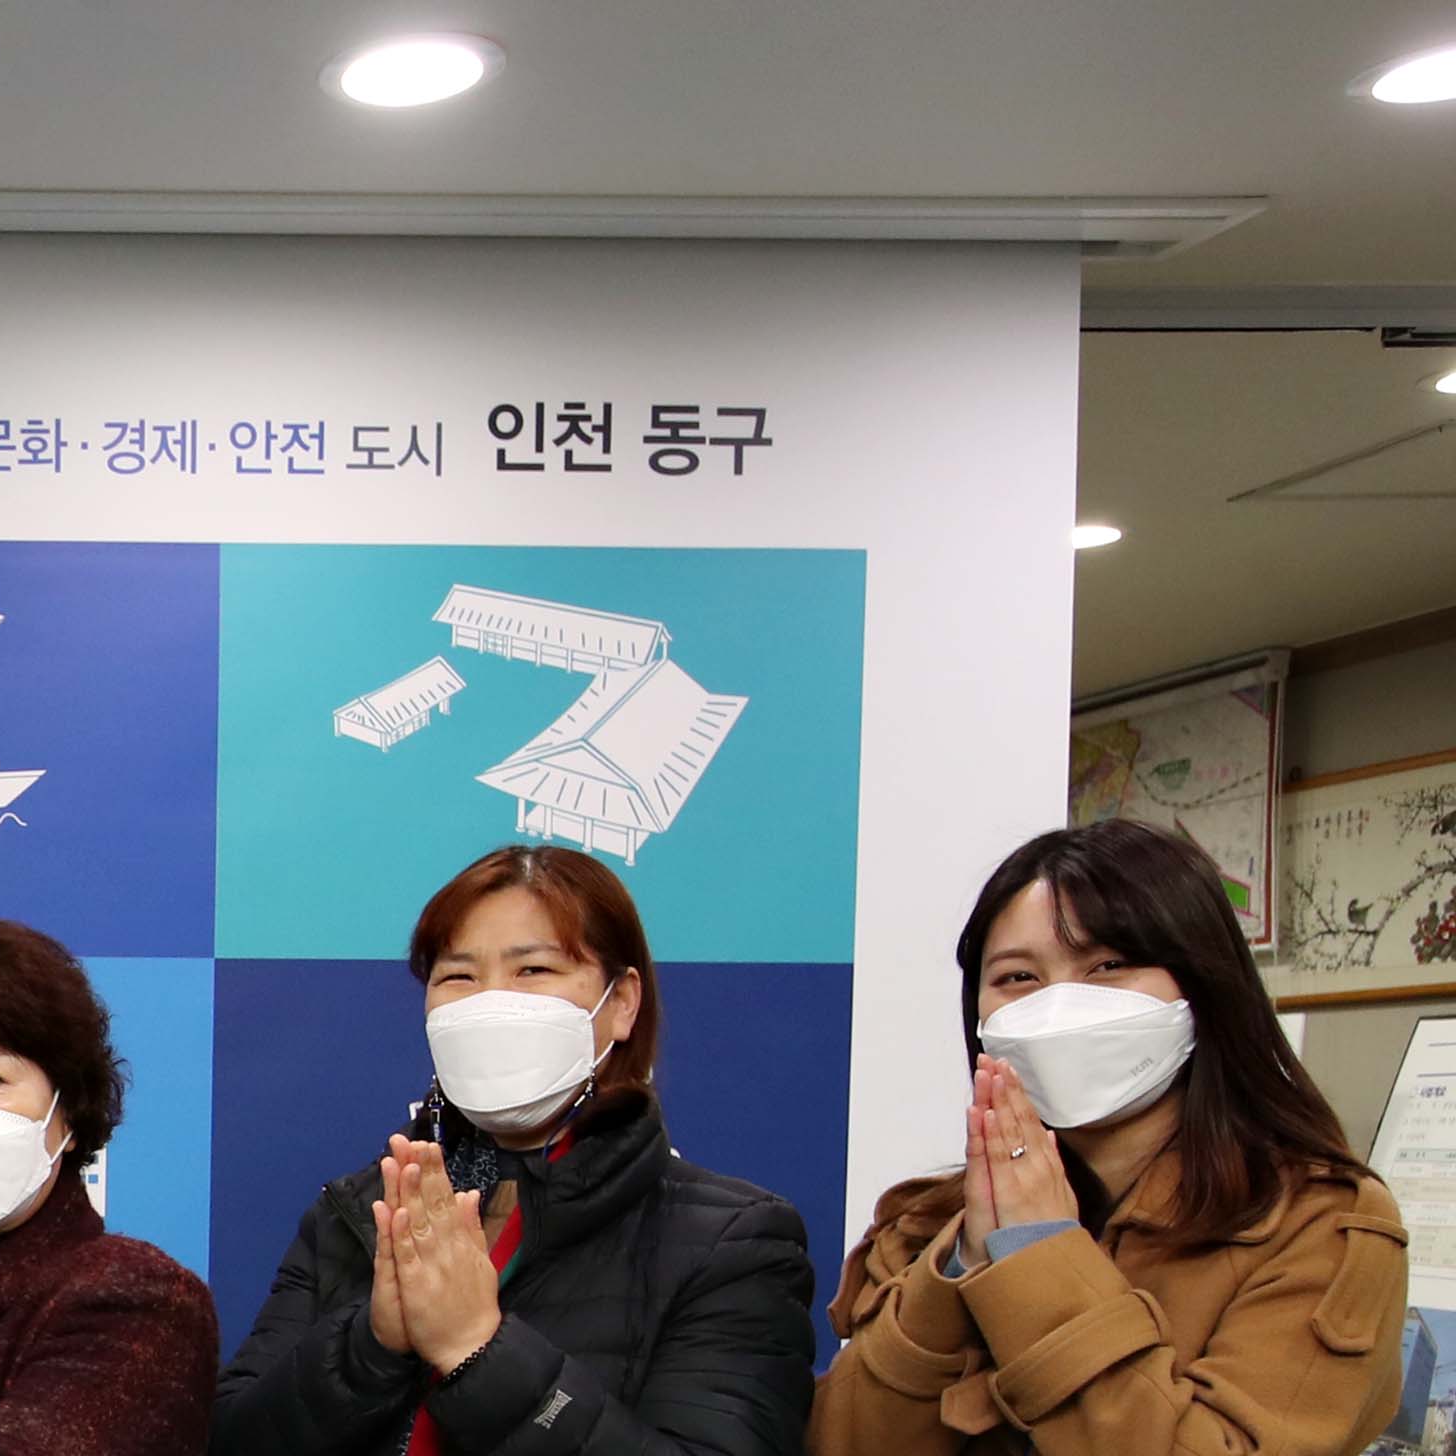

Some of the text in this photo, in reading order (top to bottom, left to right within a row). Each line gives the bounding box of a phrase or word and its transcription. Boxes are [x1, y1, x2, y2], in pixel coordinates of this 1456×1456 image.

[346, 421, 444, 477] 도시
[488, 401, 613, 472] 인천
[642, 403, 774, 477] 동구
